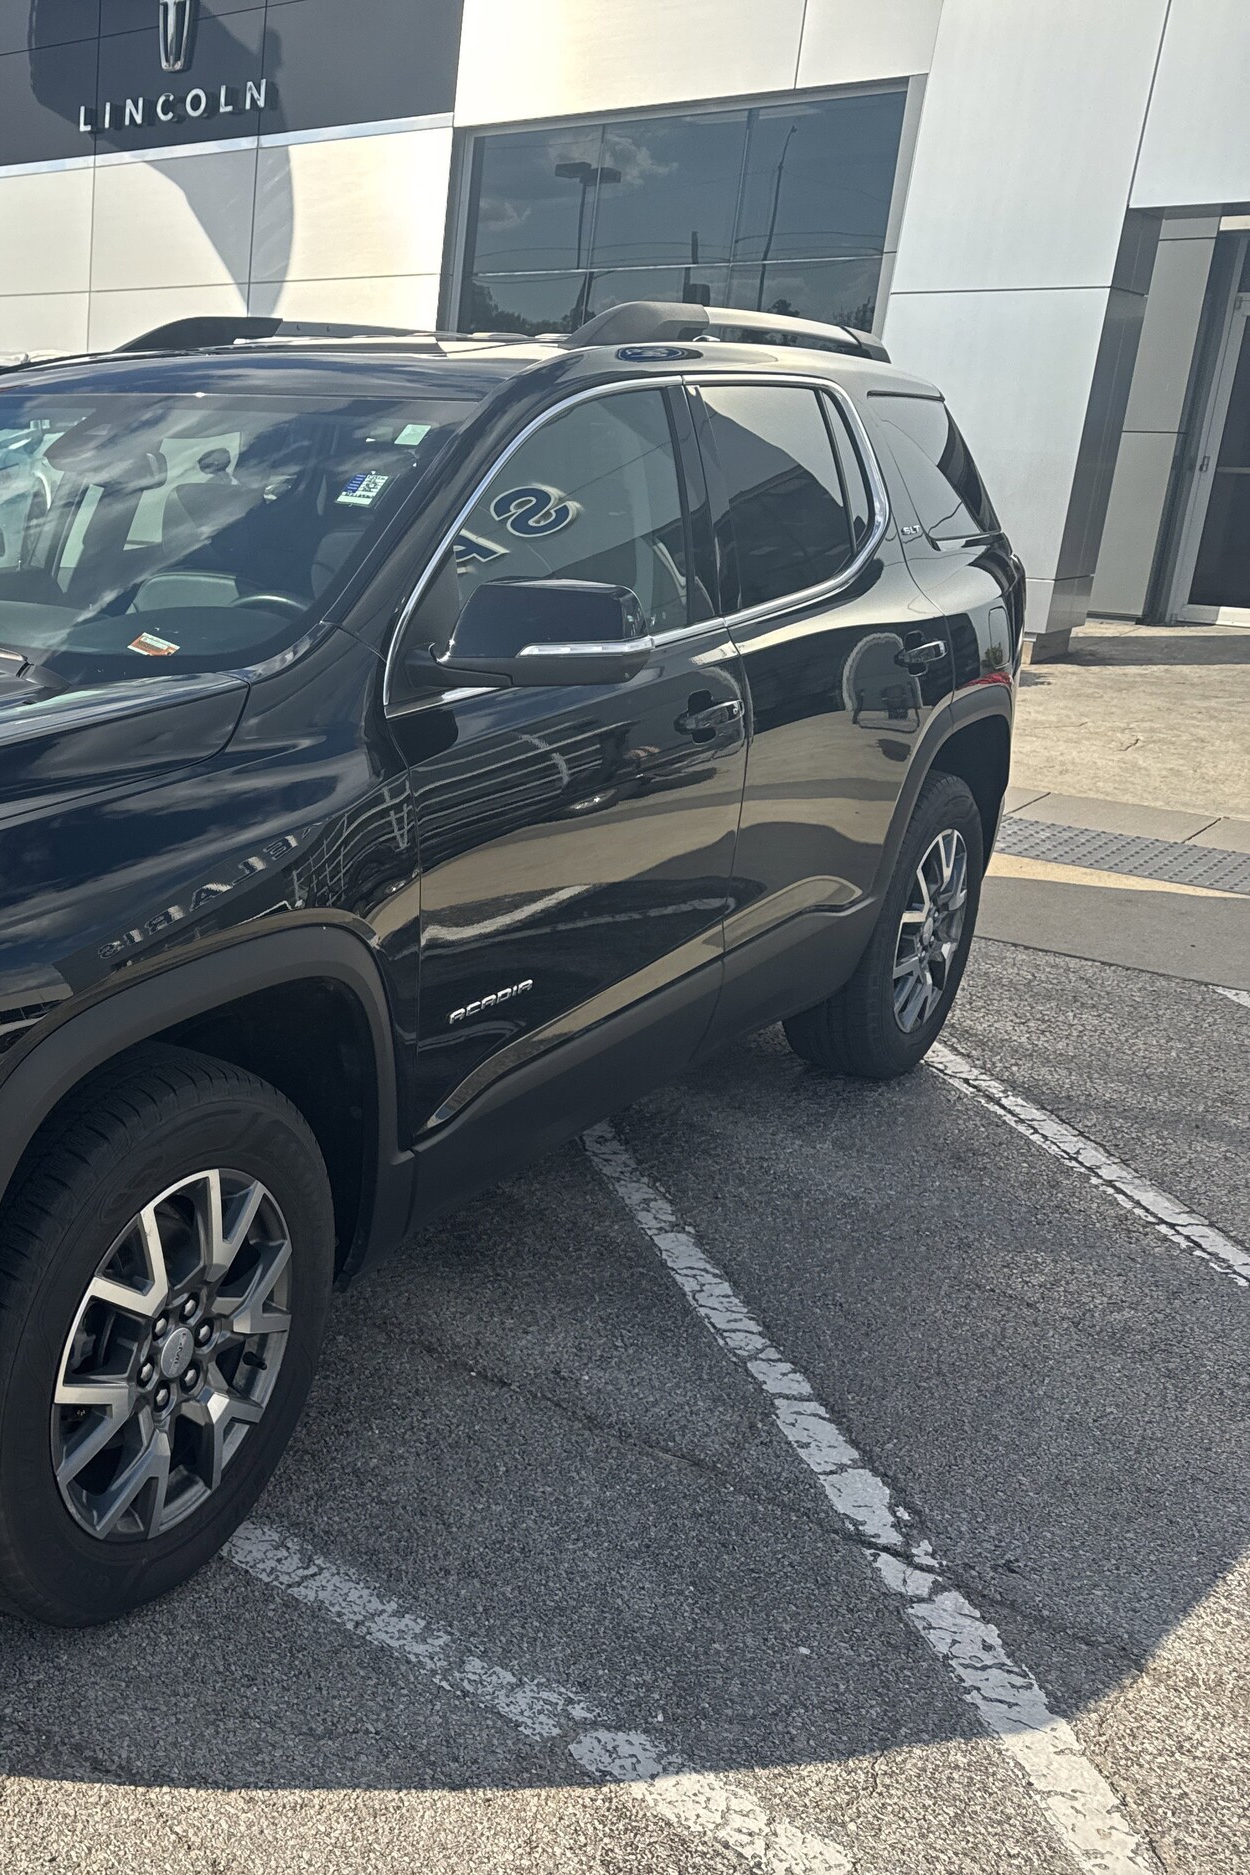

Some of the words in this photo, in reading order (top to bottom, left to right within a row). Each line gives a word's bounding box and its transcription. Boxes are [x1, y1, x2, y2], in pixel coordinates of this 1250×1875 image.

[79, 78, 267, 132] LINCOLN
[902, 525, 920, 535] SLT
[449, 979, 534, 1025] ACADIA
